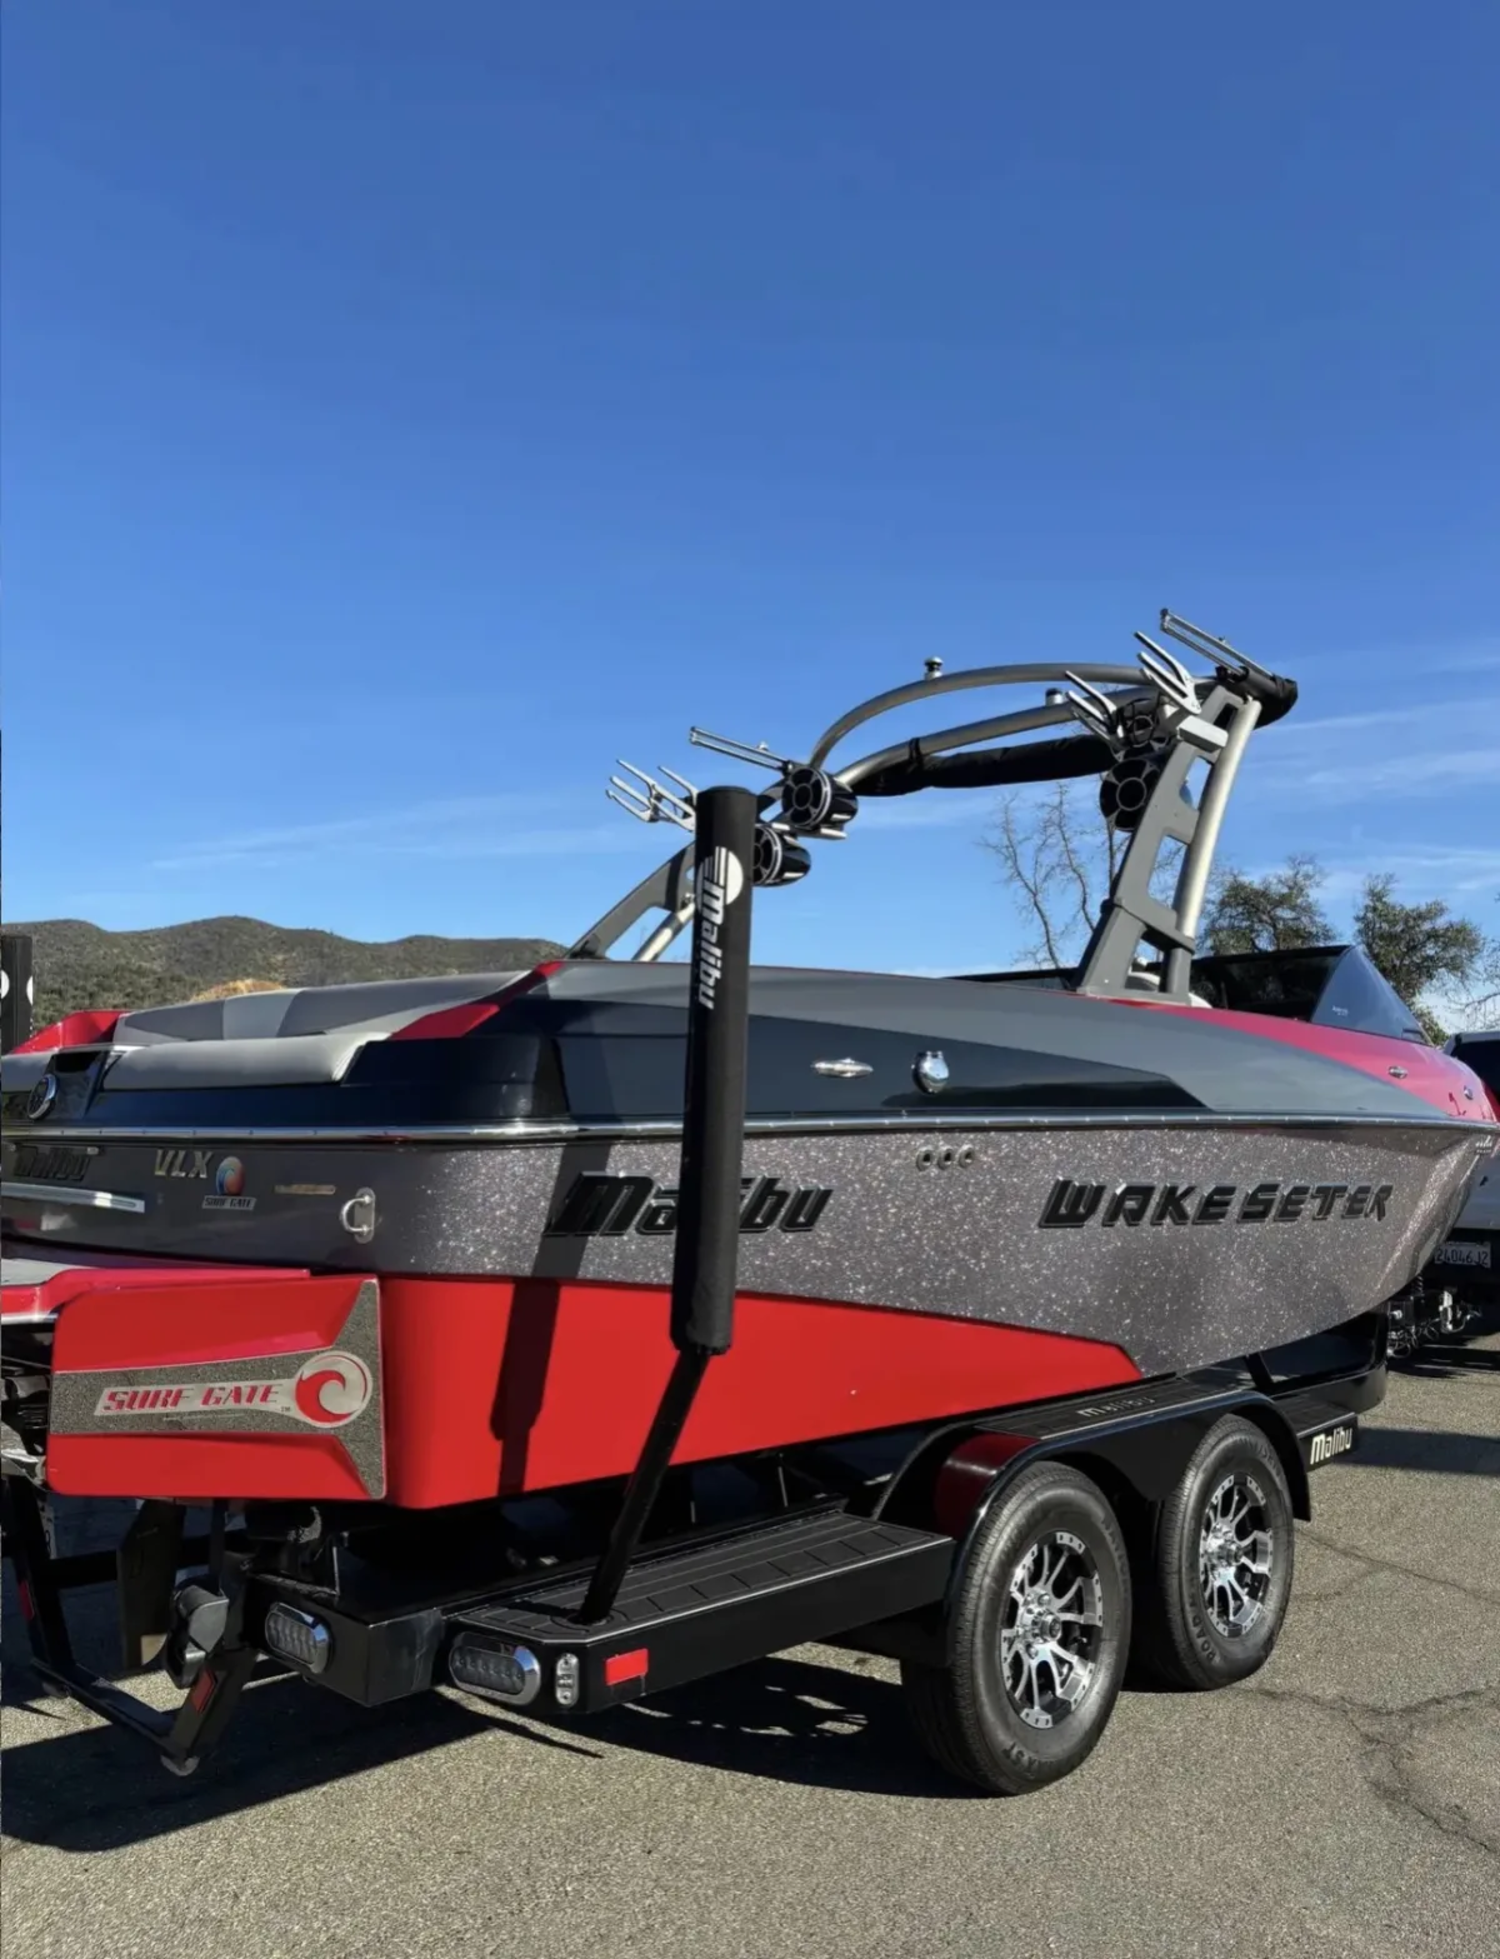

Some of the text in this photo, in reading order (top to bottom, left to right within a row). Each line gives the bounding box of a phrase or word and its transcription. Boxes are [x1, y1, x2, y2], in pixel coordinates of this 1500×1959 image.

[699, 879, 726, 1010] Malibu
[154, 1149, 213, 1179] VLX
[103, 1388, 194, 1411] SURF
[202, 1383, 283, 1406] GATE
[1309, 1426, 1353, 1465] Malibu
